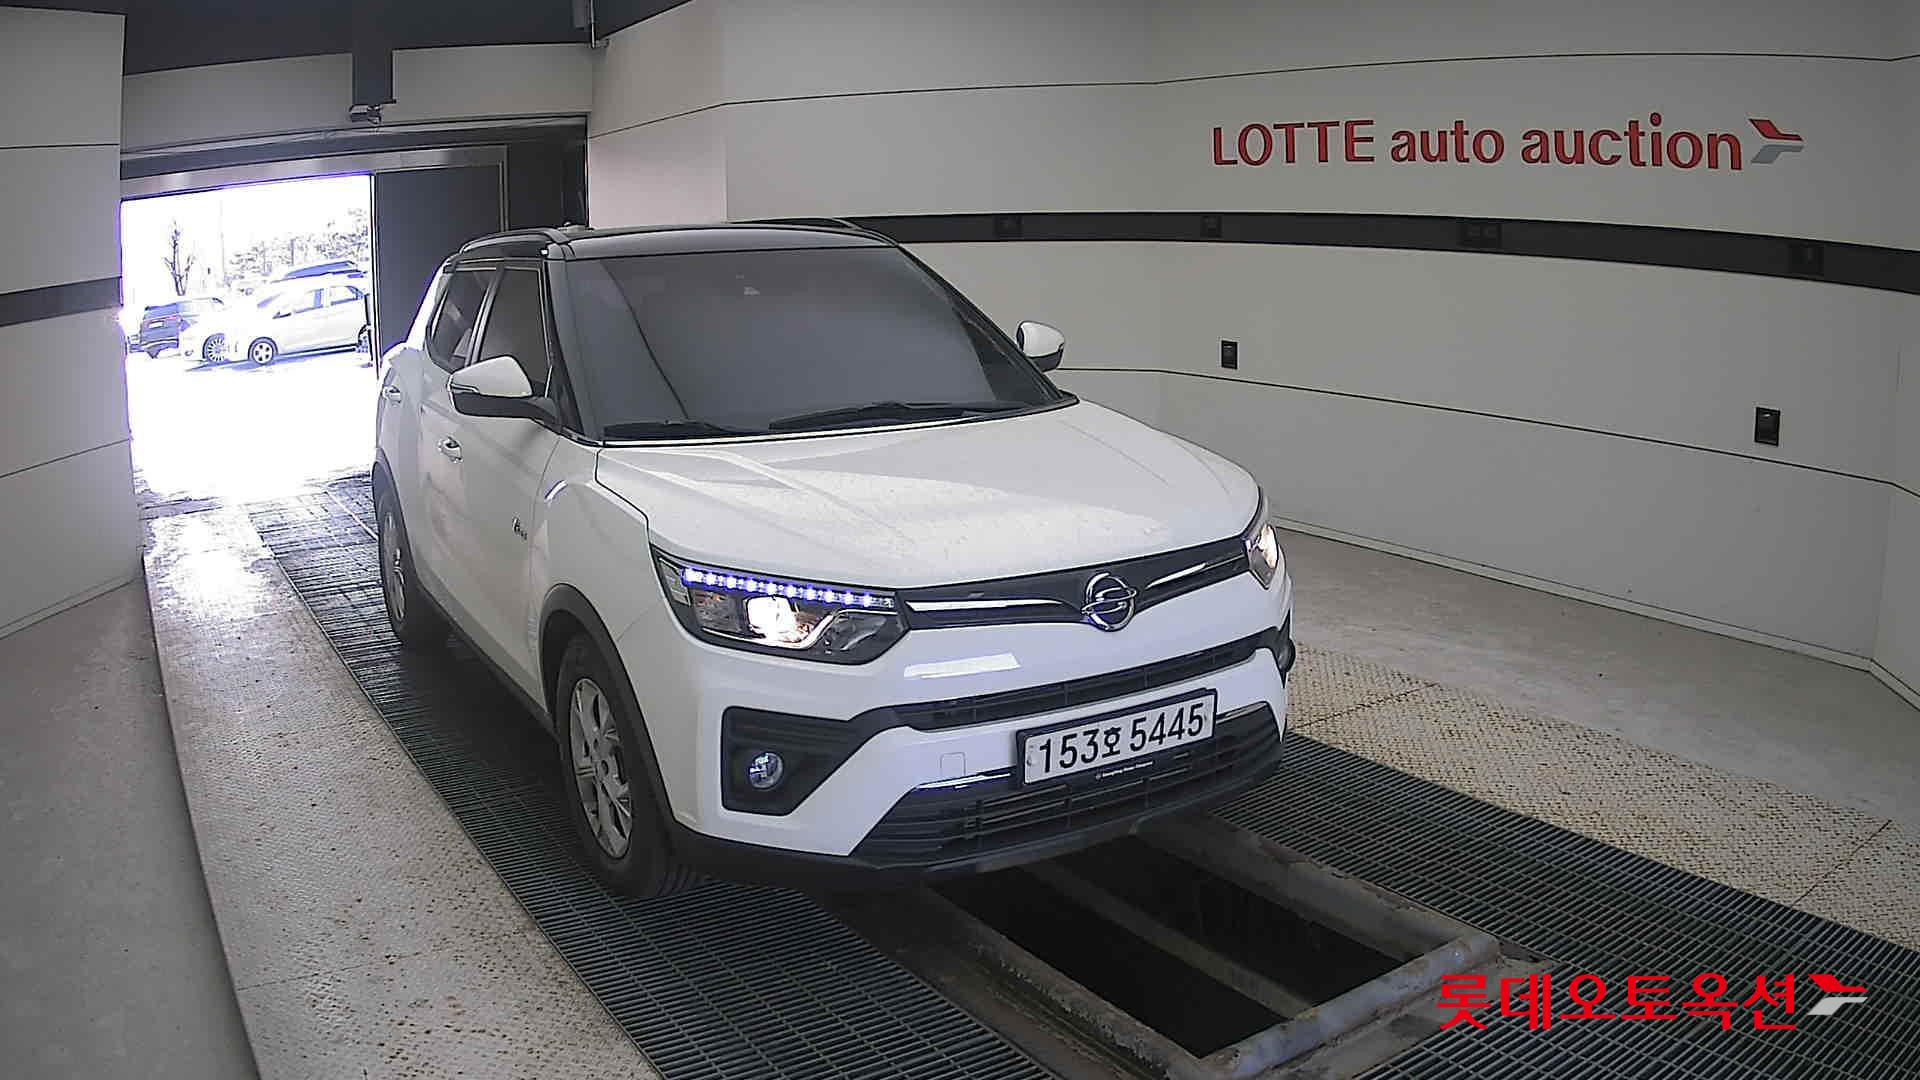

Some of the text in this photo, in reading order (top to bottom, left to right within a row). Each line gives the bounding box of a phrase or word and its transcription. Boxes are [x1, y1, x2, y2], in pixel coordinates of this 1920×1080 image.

[1212, 112, 1743, 171] LOTTE auto auction
[1039, 726, 1121, 773] 153호
[1129, 702, 1204, 751] 5445
